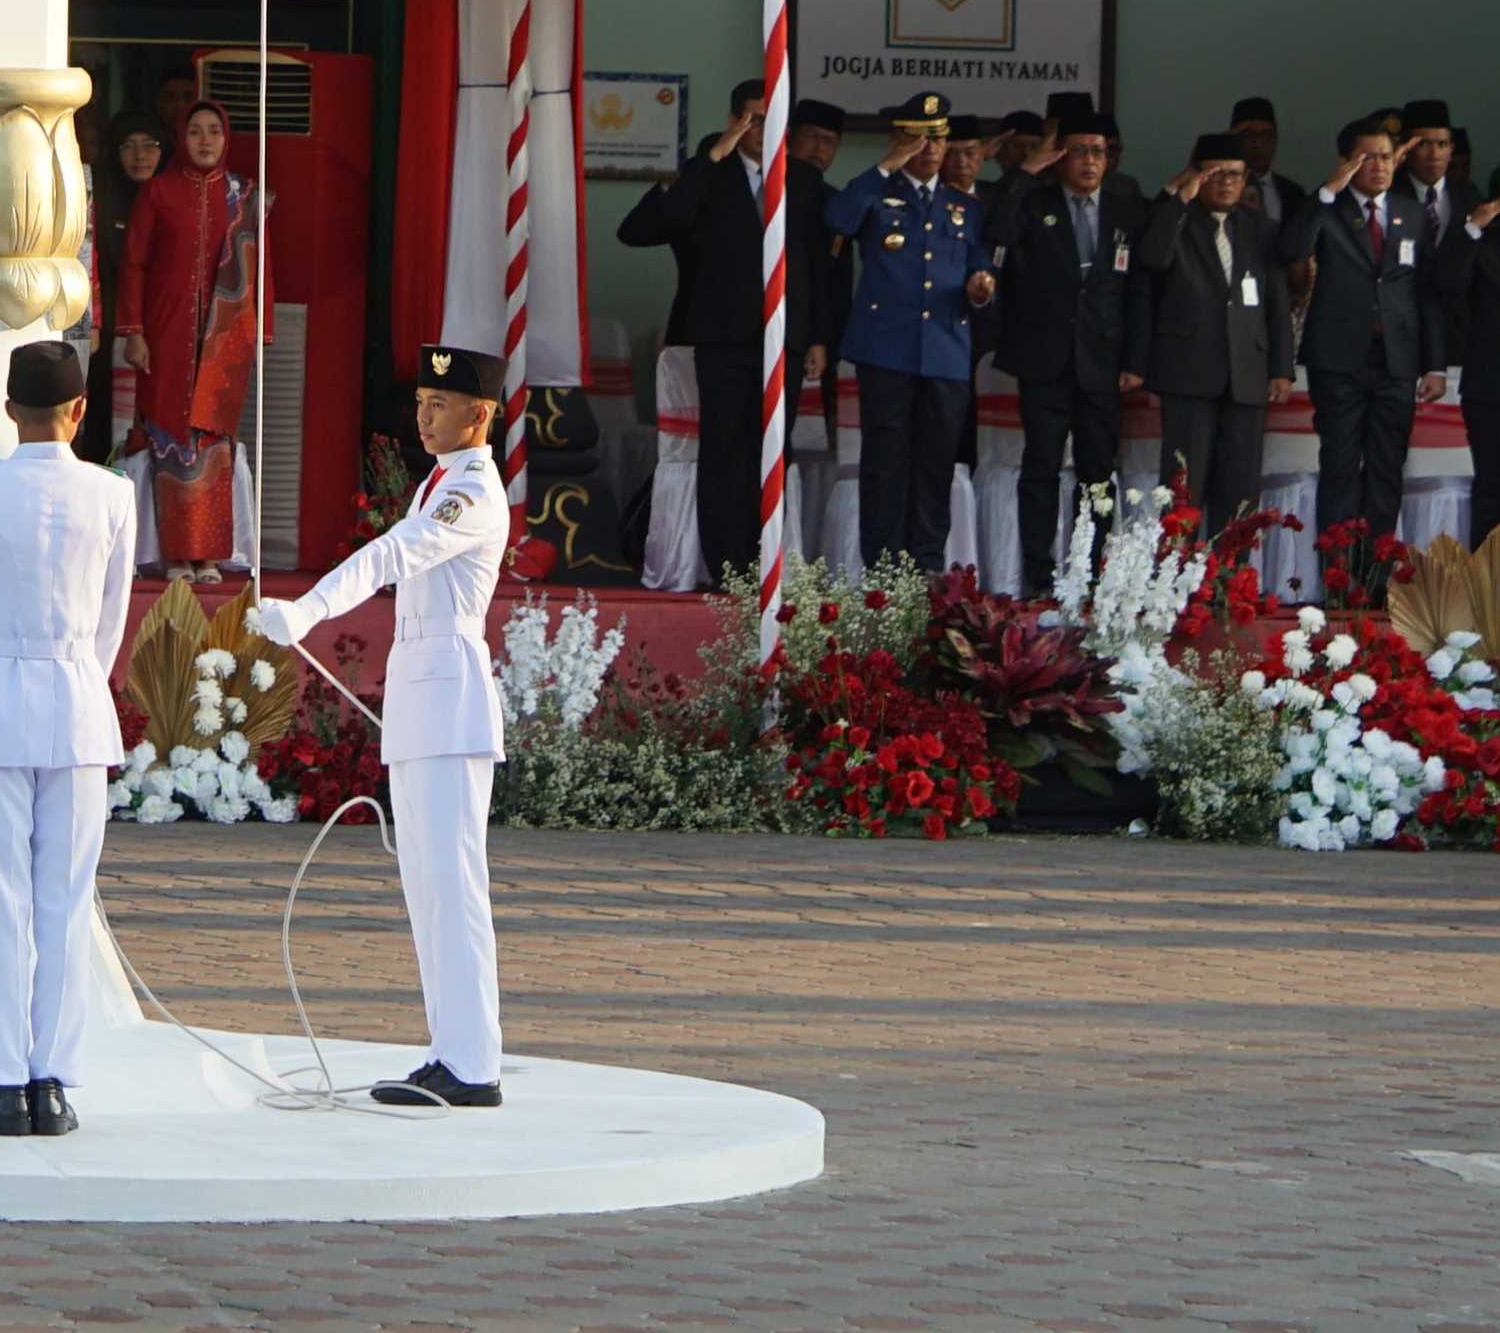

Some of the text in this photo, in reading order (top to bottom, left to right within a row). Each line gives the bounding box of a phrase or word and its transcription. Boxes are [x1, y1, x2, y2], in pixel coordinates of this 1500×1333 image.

[820, 55, 1080, 82] JOGJA BERHATI NYAMAN
